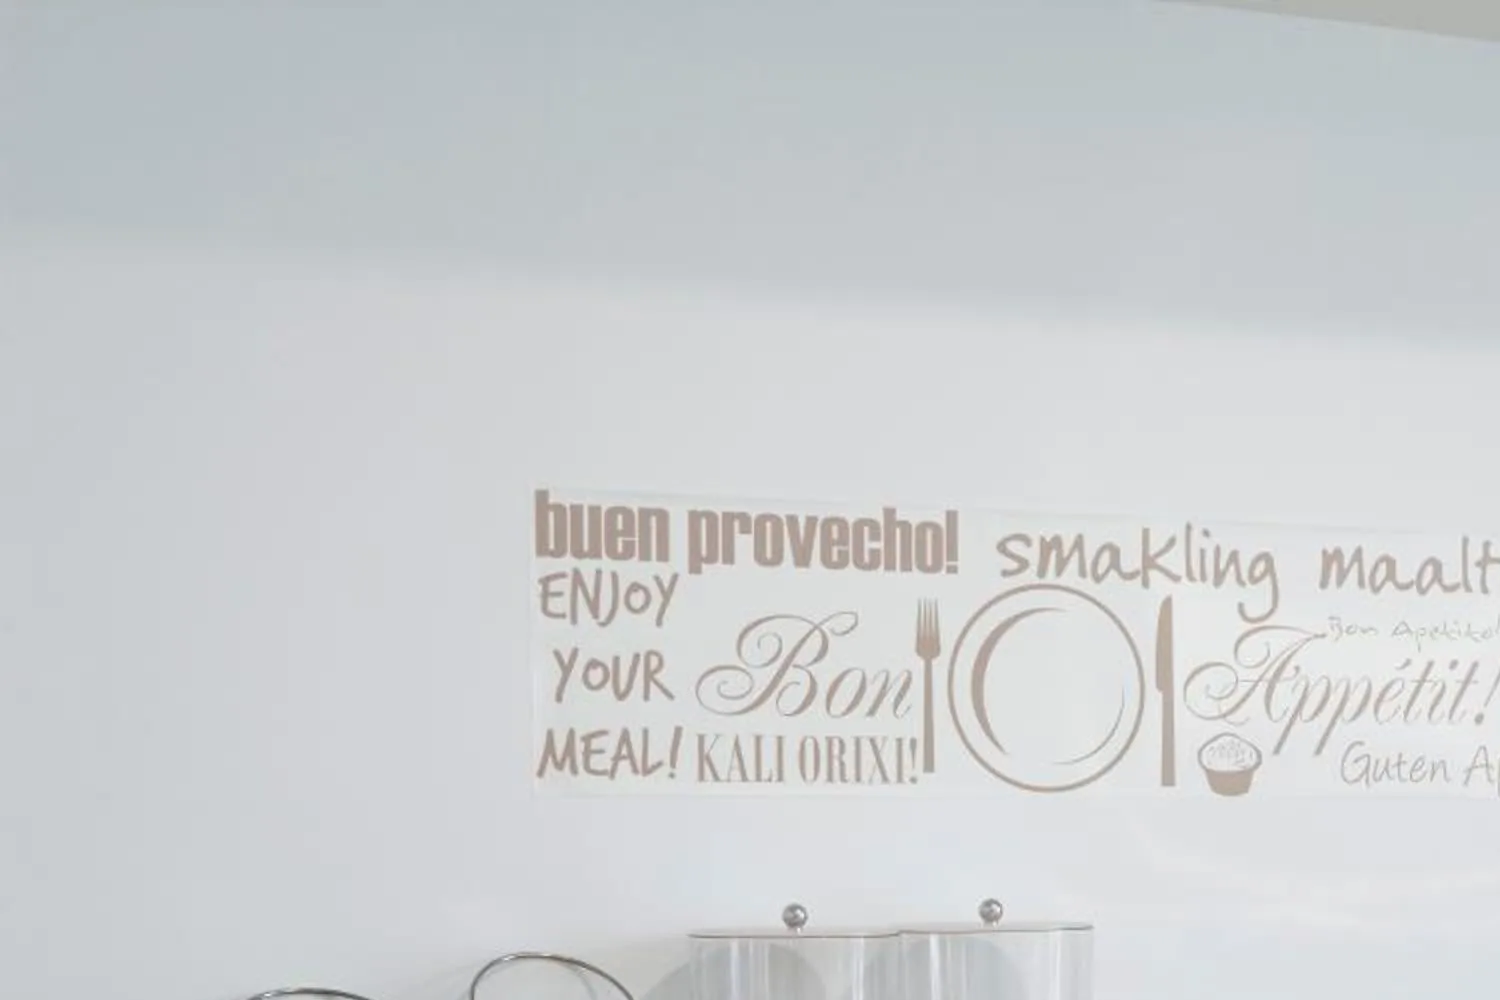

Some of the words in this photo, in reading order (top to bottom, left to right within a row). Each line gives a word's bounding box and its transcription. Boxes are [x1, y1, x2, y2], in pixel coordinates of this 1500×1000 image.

[535, 490, 669, 562] buen
[688, 507, 958, 575] provecho!
[537, 567, 679, 627] ENJOY
[996, 521, 1279, 624] smakling
[553, 646, 675, 703] YOUR
[695, 610, 914, 718] Bon
[536, 726, 683, 781] MEAL!
[696, 733, 786, 783] KALI
[1340, 740, 1450, 788] Guten
